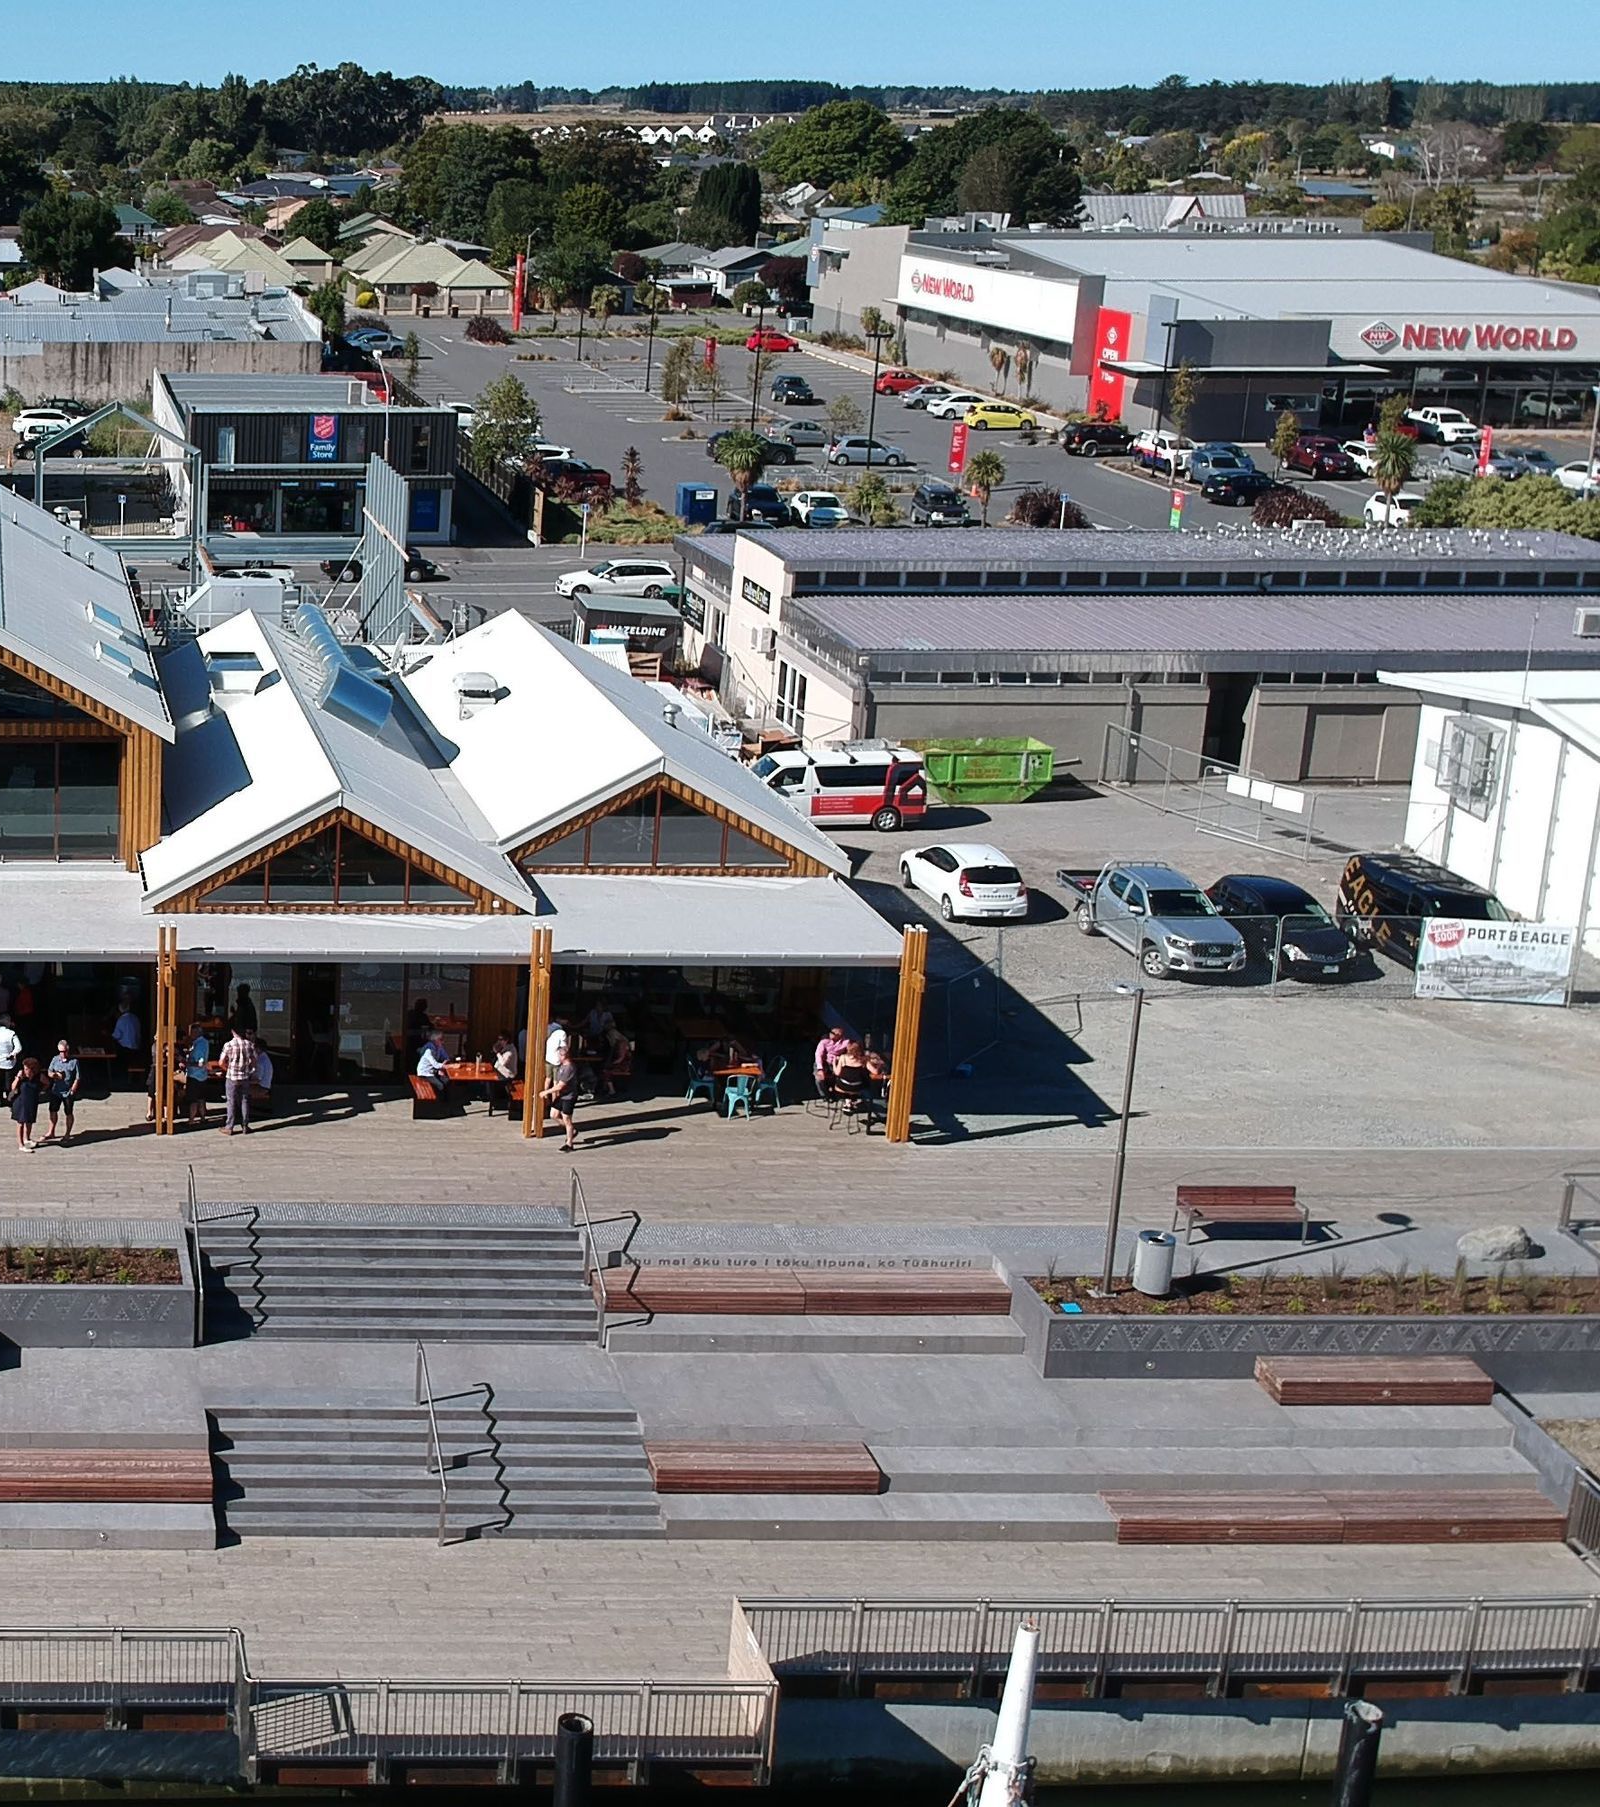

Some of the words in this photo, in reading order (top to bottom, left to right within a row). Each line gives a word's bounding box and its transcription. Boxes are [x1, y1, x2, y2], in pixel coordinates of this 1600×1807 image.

[922, 273, 941, 296] NEW
[943, 277, 975, 303] WORLD
[1369, 331, 1389, 340] NW
[1402, 322, 1470, 351] NEW
[1474, 324, 1578, 352] WORLD
[310, 443, 336, 452] Family
[312, 451, 333, 459] Store
[1434, 930, 1459, 943] SOON
[727, 1258, 758, 1267] ture
[877, 1259, 896, 1267] ko
